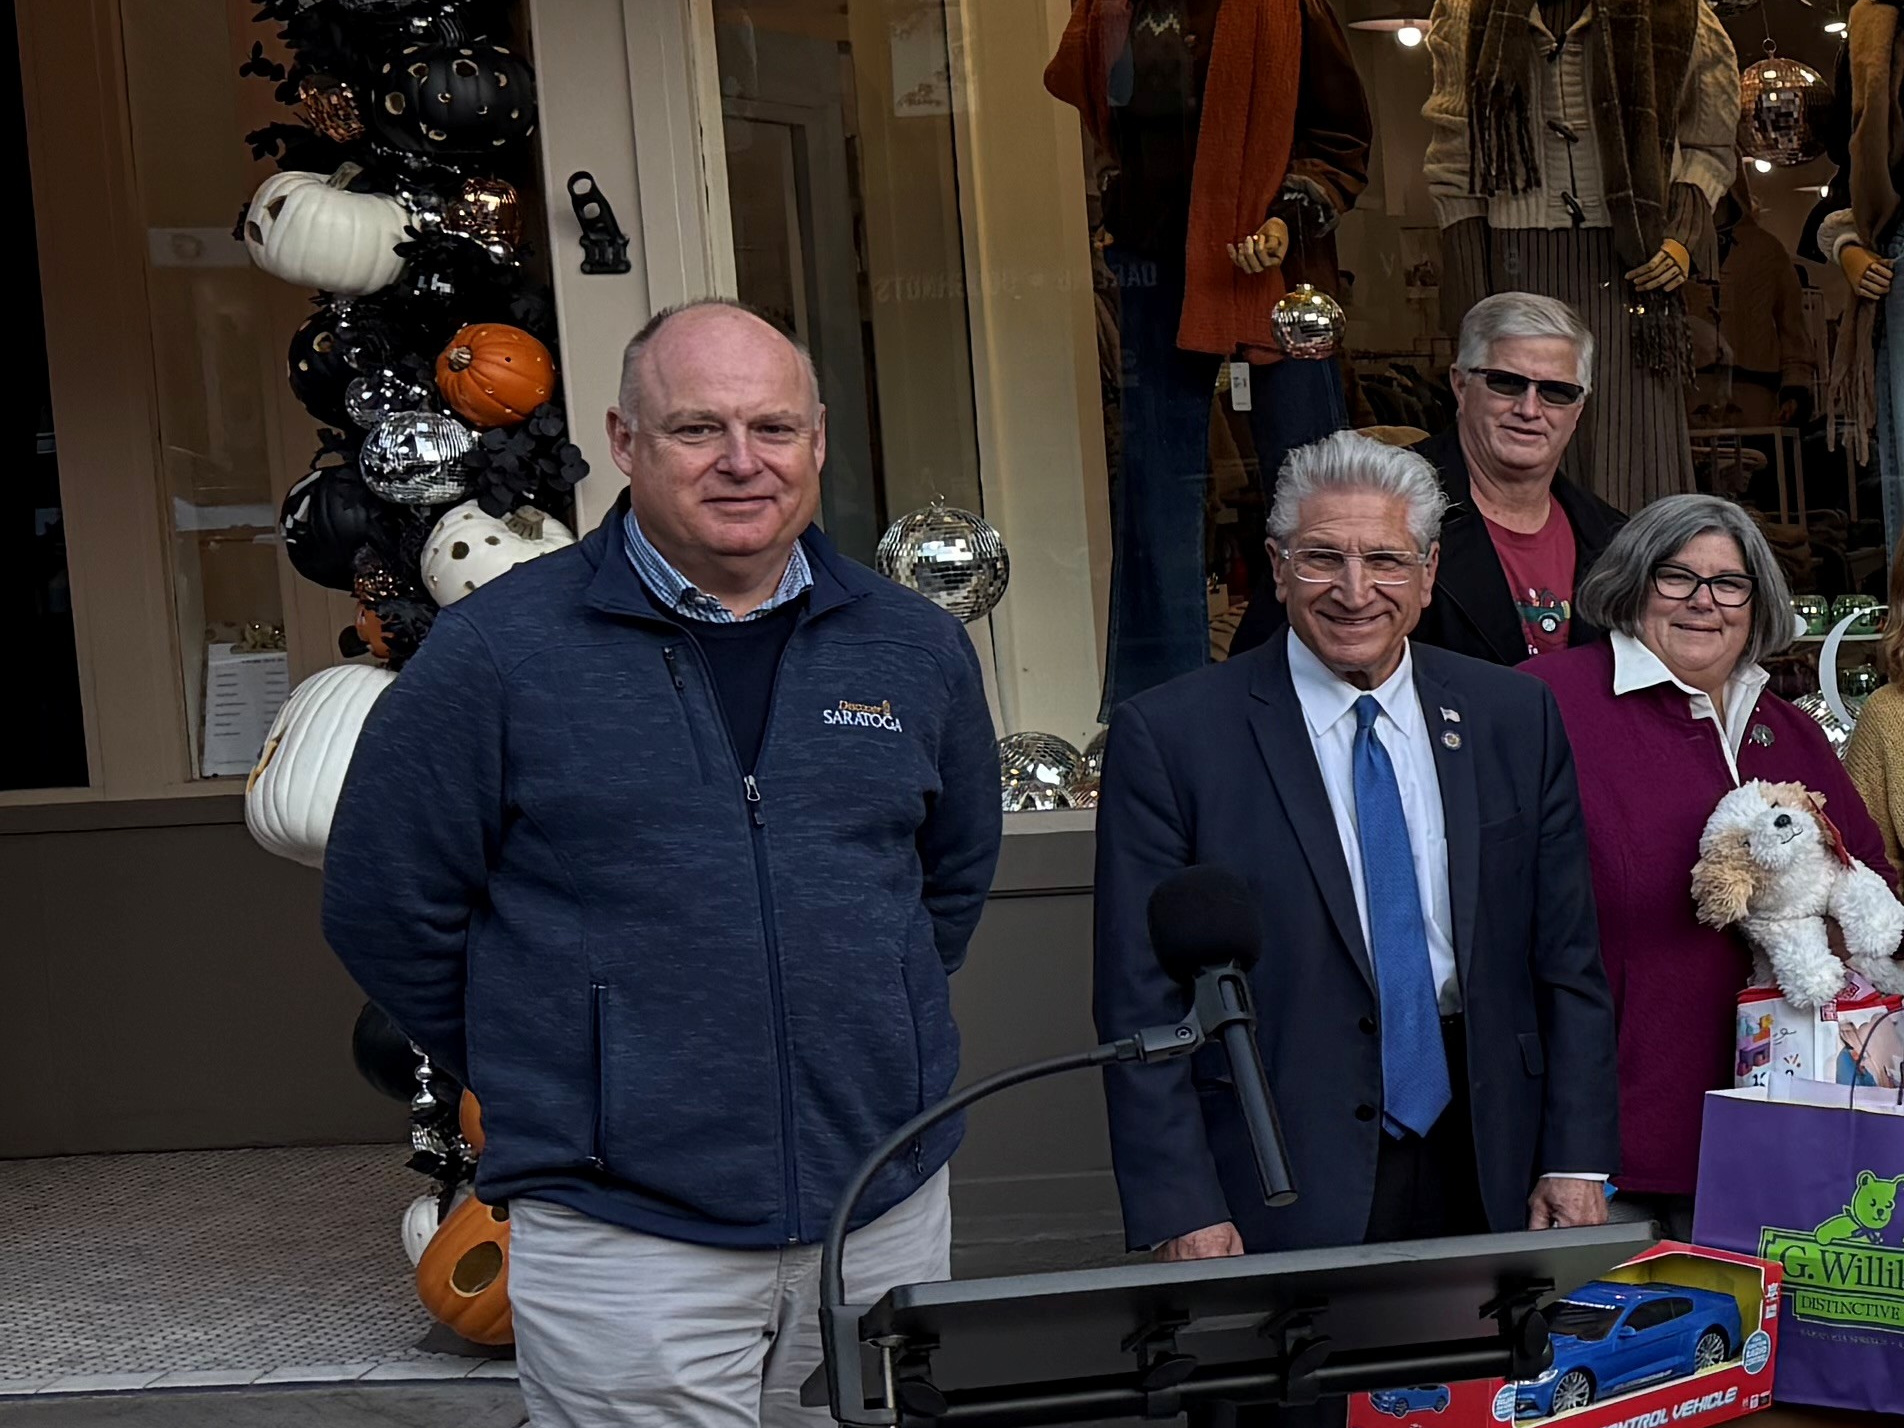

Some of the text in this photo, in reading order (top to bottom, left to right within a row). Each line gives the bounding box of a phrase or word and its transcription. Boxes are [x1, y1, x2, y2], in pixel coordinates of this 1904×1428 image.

[823, 709, 903, 732] SARATOGA
[1781, 1243, 1815, 1282] G.
[1799, 1294, 1901, 1323] DISTINCTIVE
